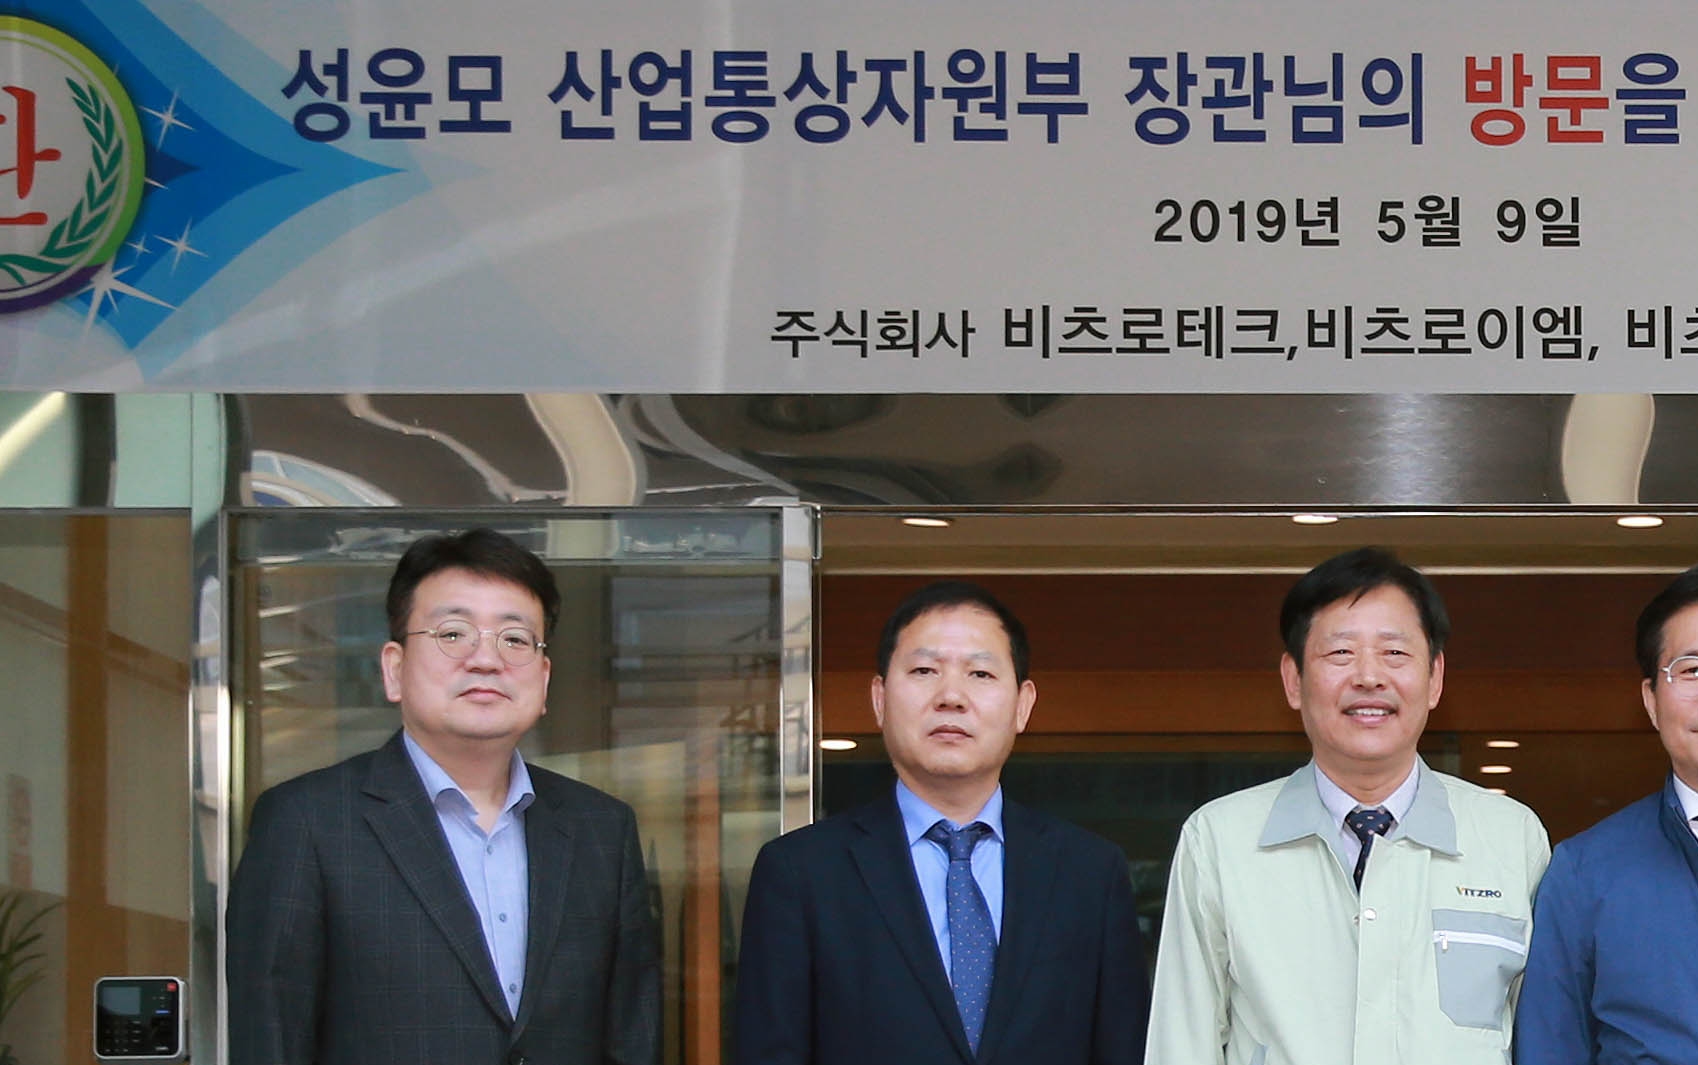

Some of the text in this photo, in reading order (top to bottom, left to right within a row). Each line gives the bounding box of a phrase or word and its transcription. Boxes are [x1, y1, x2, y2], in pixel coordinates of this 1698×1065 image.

[280, 47, 512, 144] 성윤모
[547, 48, 1089, 145] 산업통상자원부
[1124, 51, 1424, 146] 장관님의
[1464, 52, 1687, 147] 방문을
[1153, 194, 1582, 248] 2019년 5월 9일
[769, 308, 976, 360] 주식회사
[1456, 886, 1502, 898] VITZRO
